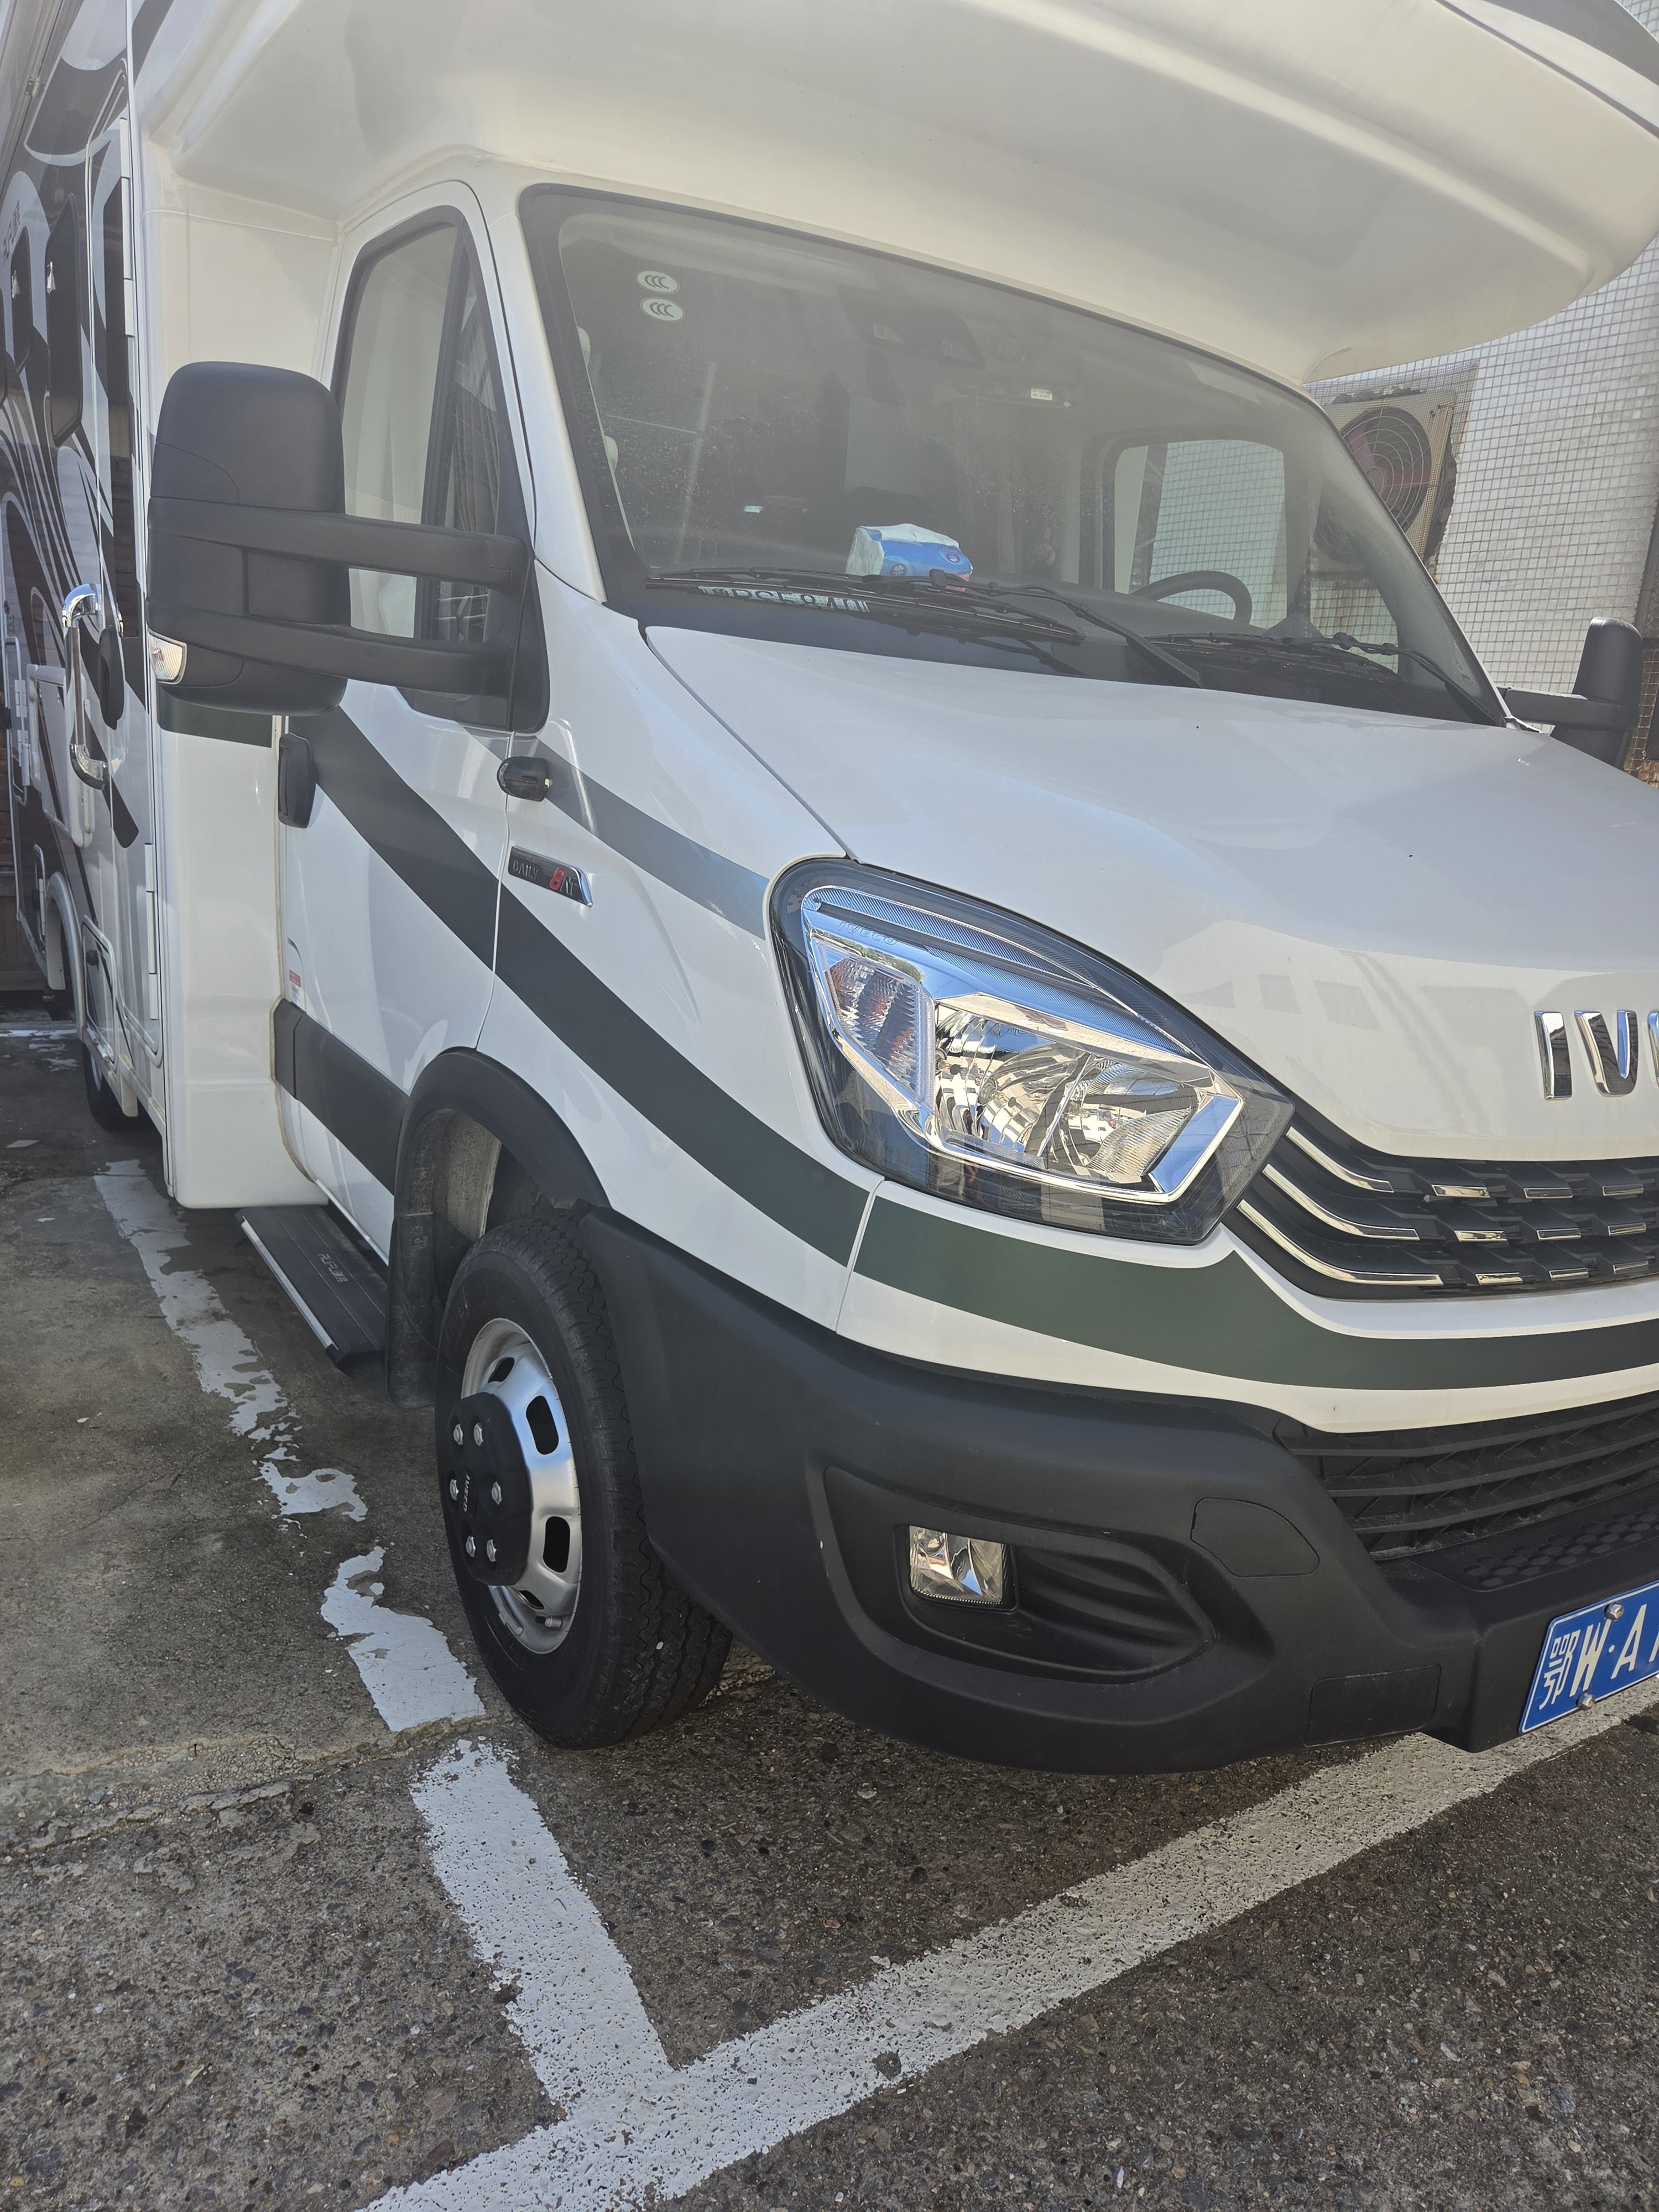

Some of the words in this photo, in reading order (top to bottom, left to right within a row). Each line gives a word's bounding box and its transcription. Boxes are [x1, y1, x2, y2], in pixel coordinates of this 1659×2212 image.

[513, 859, 539, 880] DAILY
[837, 921, 898, 946] IVECO
[1534, 1009, 1659, 1101] IV
[1539, 1603, 1659, 1710] 鄂W·A
